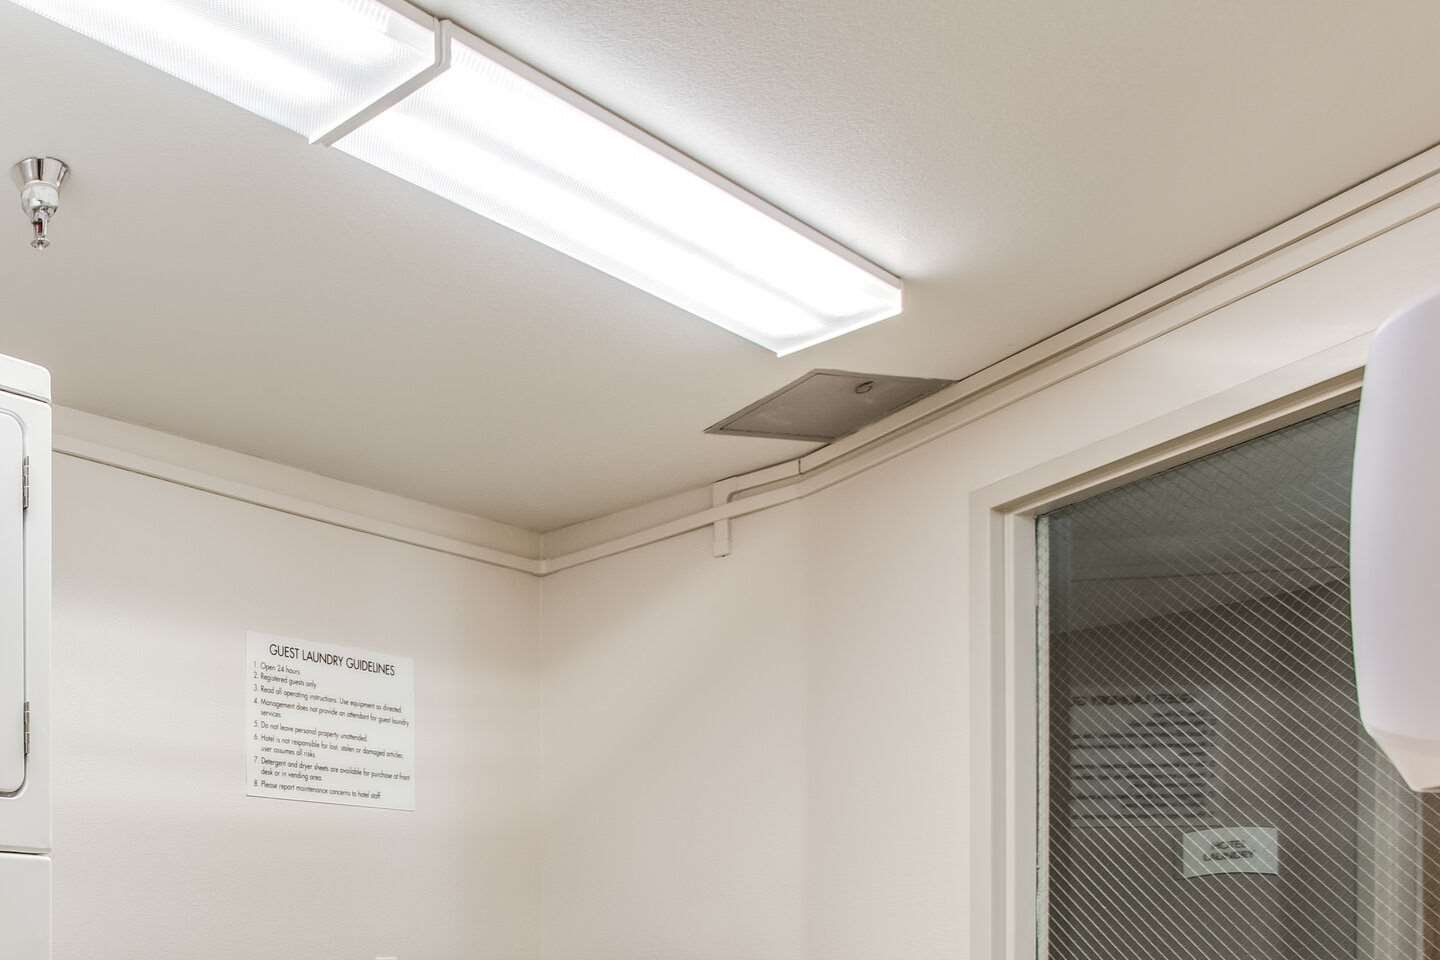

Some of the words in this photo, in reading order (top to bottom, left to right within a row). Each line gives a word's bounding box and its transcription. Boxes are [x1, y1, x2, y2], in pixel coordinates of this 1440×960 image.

[260, 662, 276, 671] Open
[277, 664, 285, 672] 24
[269, 644, 300, 660] GUEST
[302, 649, 344, 667] LAUNDRY
[346, 657, 396, 676] GUIDELINES
